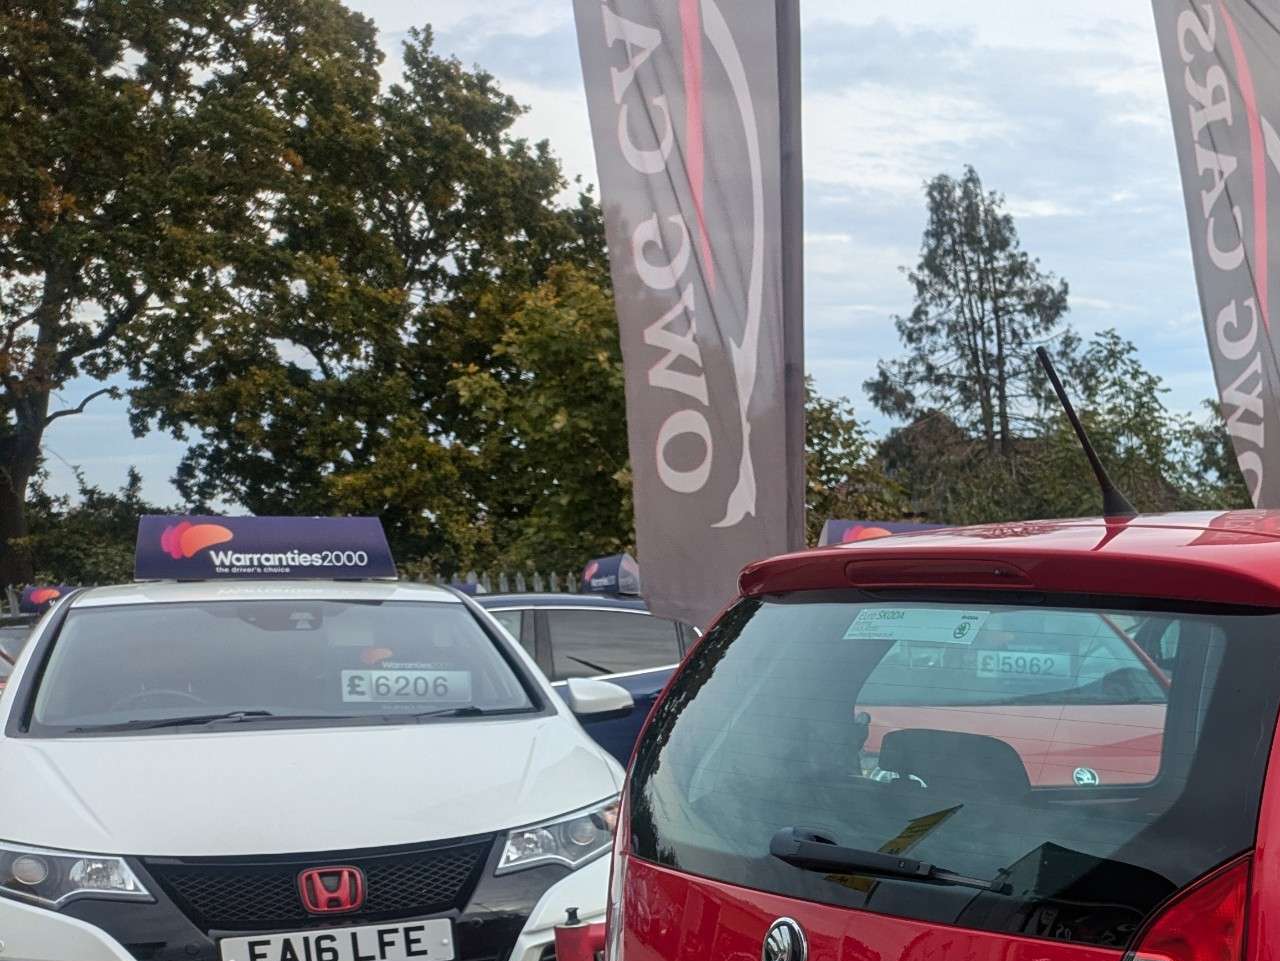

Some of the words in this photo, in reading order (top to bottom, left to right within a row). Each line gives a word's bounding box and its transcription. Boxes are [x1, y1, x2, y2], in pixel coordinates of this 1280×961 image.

[209, 549, 369, 568] Warranties2000
[215, 566, 229, 574] the
[263, 566, 291, 574] choice
